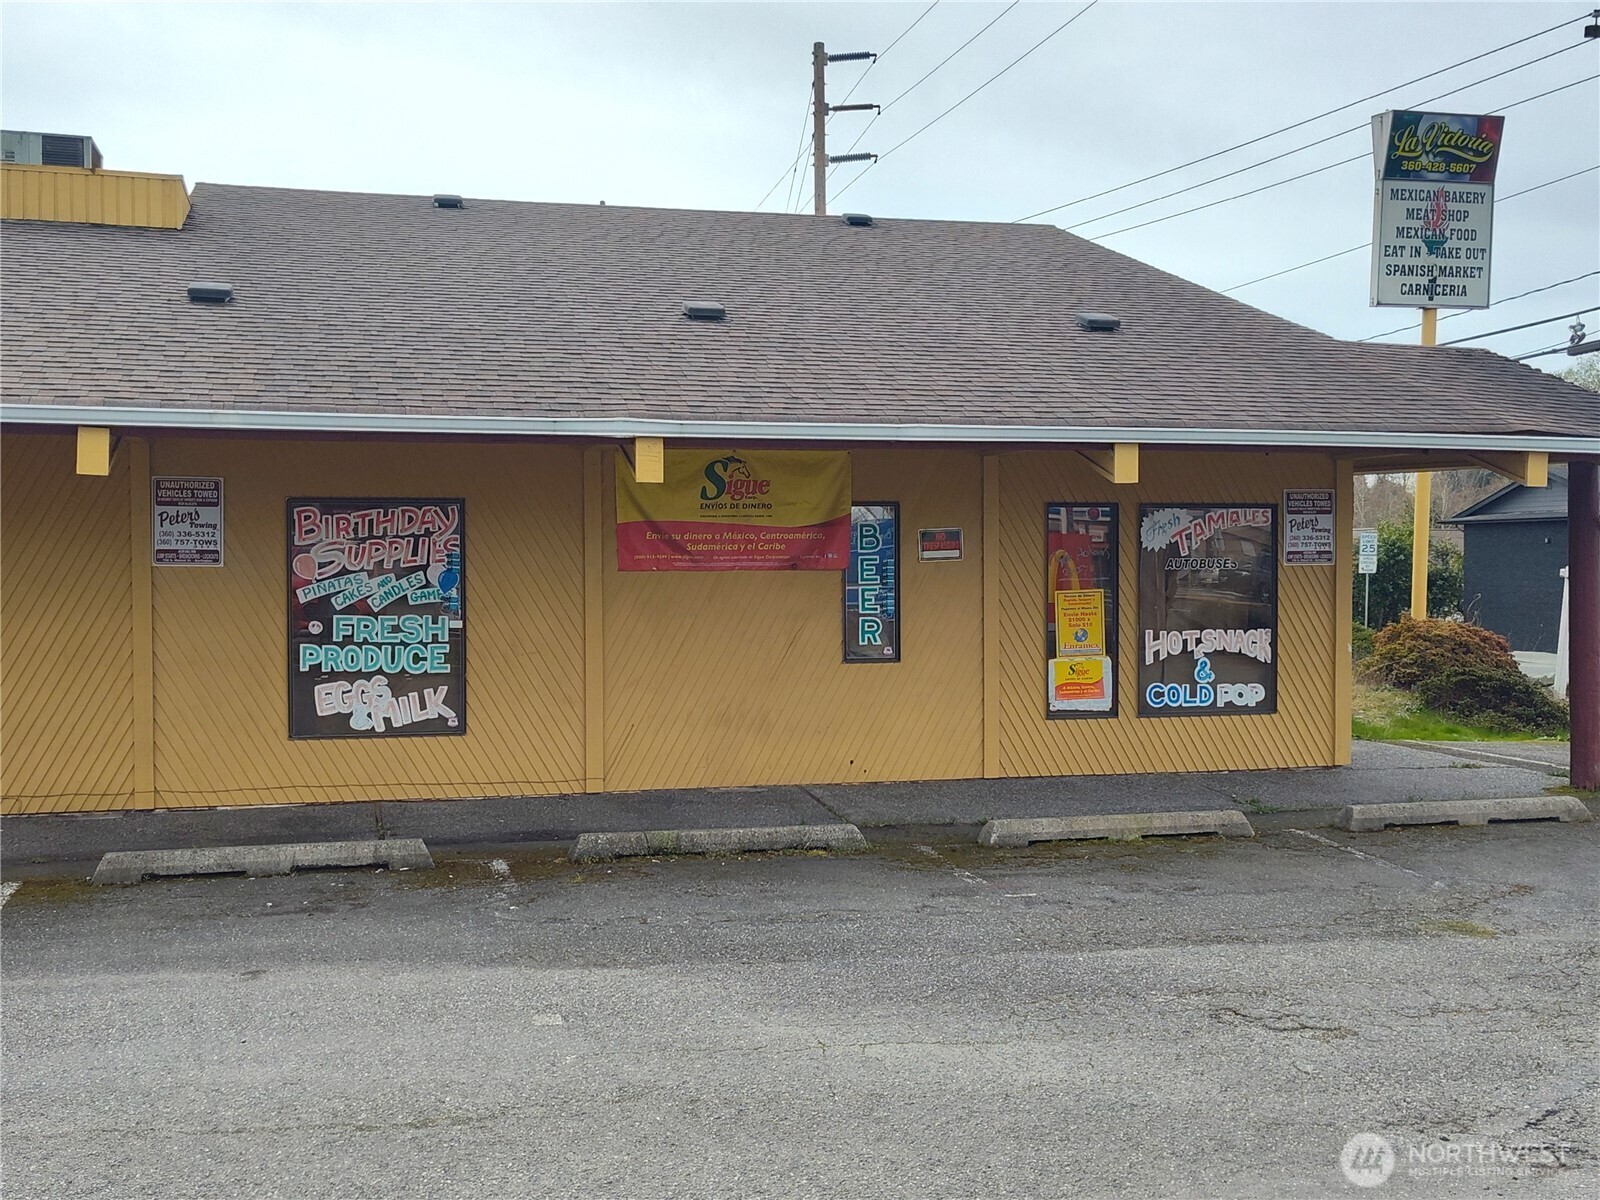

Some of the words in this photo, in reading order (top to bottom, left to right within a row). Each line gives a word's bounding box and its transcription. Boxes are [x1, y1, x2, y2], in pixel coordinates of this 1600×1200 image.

[1391, 125, 1422, 158] La
[1421, 122, 1494, 162] Victoria
[1401, 161, 1476, 173] 360-428-5607
[1390, 188, 1439, 203] MEXICAN
[1444, 190, 1486, 204] BAKERY
[1405, 208, 1436, 221] MEAT
[1440, 209, 1470, 222] SHOP
[1395, 226, 1445, 240] MEXICAN
[1449, 228, 1477, 241] FOOD
[1383, 245, 1406, 258] EAT
[1409, 245, 1422, 258] IN
[1434, 247, 1461, 259] TAKE
[1465, 247, 1487, 260] OUT
[1385, 264, 1434, 277] SPANISH
[1438, 265, 1484, 278] MARKET
[1400, 283, 1467, 297] CARNICERIA
[160, 481, 215, 489] UNAUTHORIZED
[700, 459, 772, 501] Sigue
[157, 490, 192, 498] VEHICLES
[194, 490, 218, 498] TOWED
[158, 508, 200, 528] Peter's
[190, 522, 218, 530] Towing
[294, 505, 458, 545] BIRTHDAY
[1146, 513, 1181, 542] Fresh
[722, 532, 757, 540] México,
[1171, 508, 1272, 557] TAMALES
[686, 542, 738, 551] Sudamérica
[1362, 544, 1376, 552] 25
[301, 574, 364, 600] PIÑATAS
[334, 584, 373, 607] CAKES
[376, 576, 393, 590] AND
[371, 574, 424, 608] CANDLES
[858, 522, 882, 646] BEER
[332, 615, 449, 643] FRESH
[300, 644, 450, 674] PRODUCE
[1145, 630, 1200, 665] HOT
[1068, 664, 1090, 677] Sigue
[1194, 657, 1215, 683] &
[314, 675, 392, 717] EGGS
[1146, 683, 1214, 708] COLD
[1216, 683, 1266, 707] POP
[350, 704, 373, 731] &
[371, 686, 458, 733] MILK
